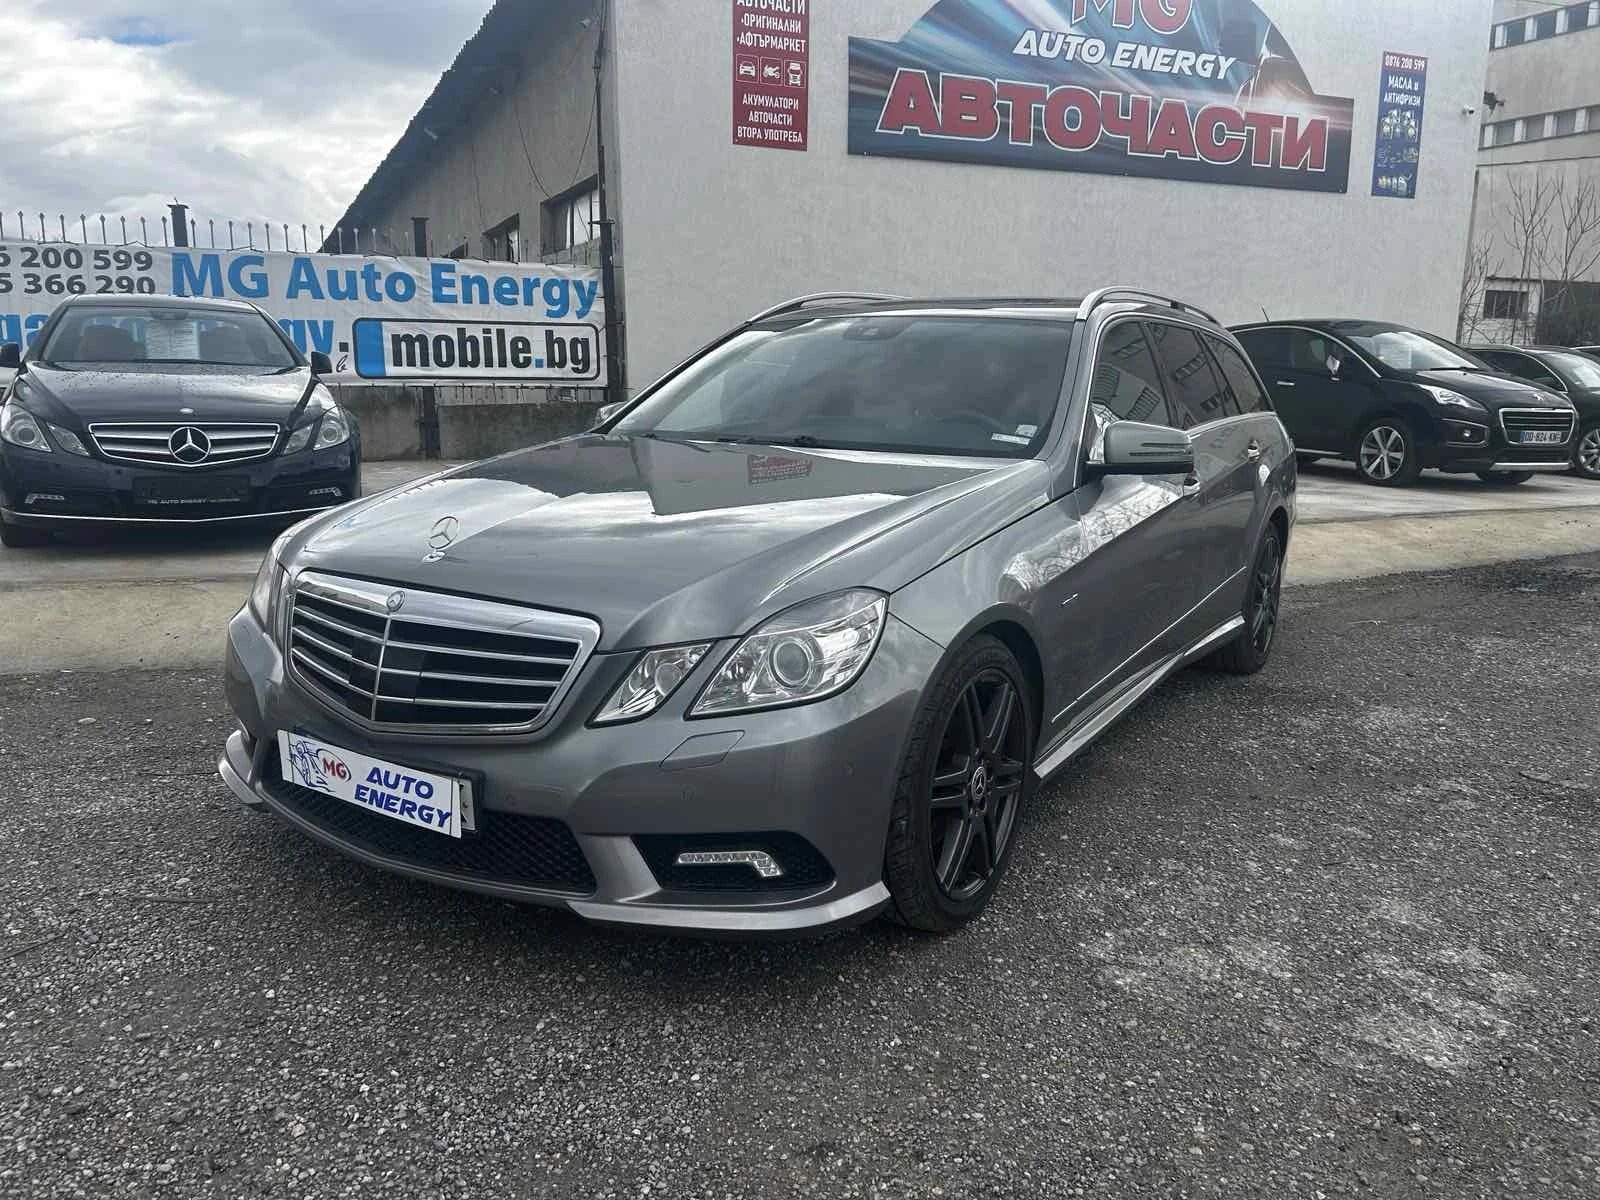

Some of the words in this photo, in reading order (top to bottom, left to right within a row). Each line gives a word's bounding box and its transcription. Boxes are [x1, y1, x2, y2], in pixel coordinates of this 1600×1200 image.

[1013, 30, 1106, 64] AUTO
[1112, 41, 1237, 80] ENERGY
[1388, 75, 1412, 90] МАСЛА
[742, 93, 799, 111] АКУМУЛАТОРИ
[748, 110, 793, 126] АВТОЧАСТИ
[875, 67, 1329, 172] АВТОЧАСТИ
[737, 126, 762, 140] ВТОРА
[764, 128, 803, 144] УПОТРЕБА
[20, 247, 83, 269] 200
[93, 249, 153, 271] 599
[23, 273, 86, 294] 366
[95, 275, 156, 294] 290
[171, 253, 270, 299] MG
[286, 256, 416, 303] Auto
[431, 263, 599, 320] Energy
[391, 327, 590, 374] mobile.bg
[322, 757, 347, 781] MG
[366, 767, 434, 800] AUTO
[354, 784, 453, 828] ENERGY
